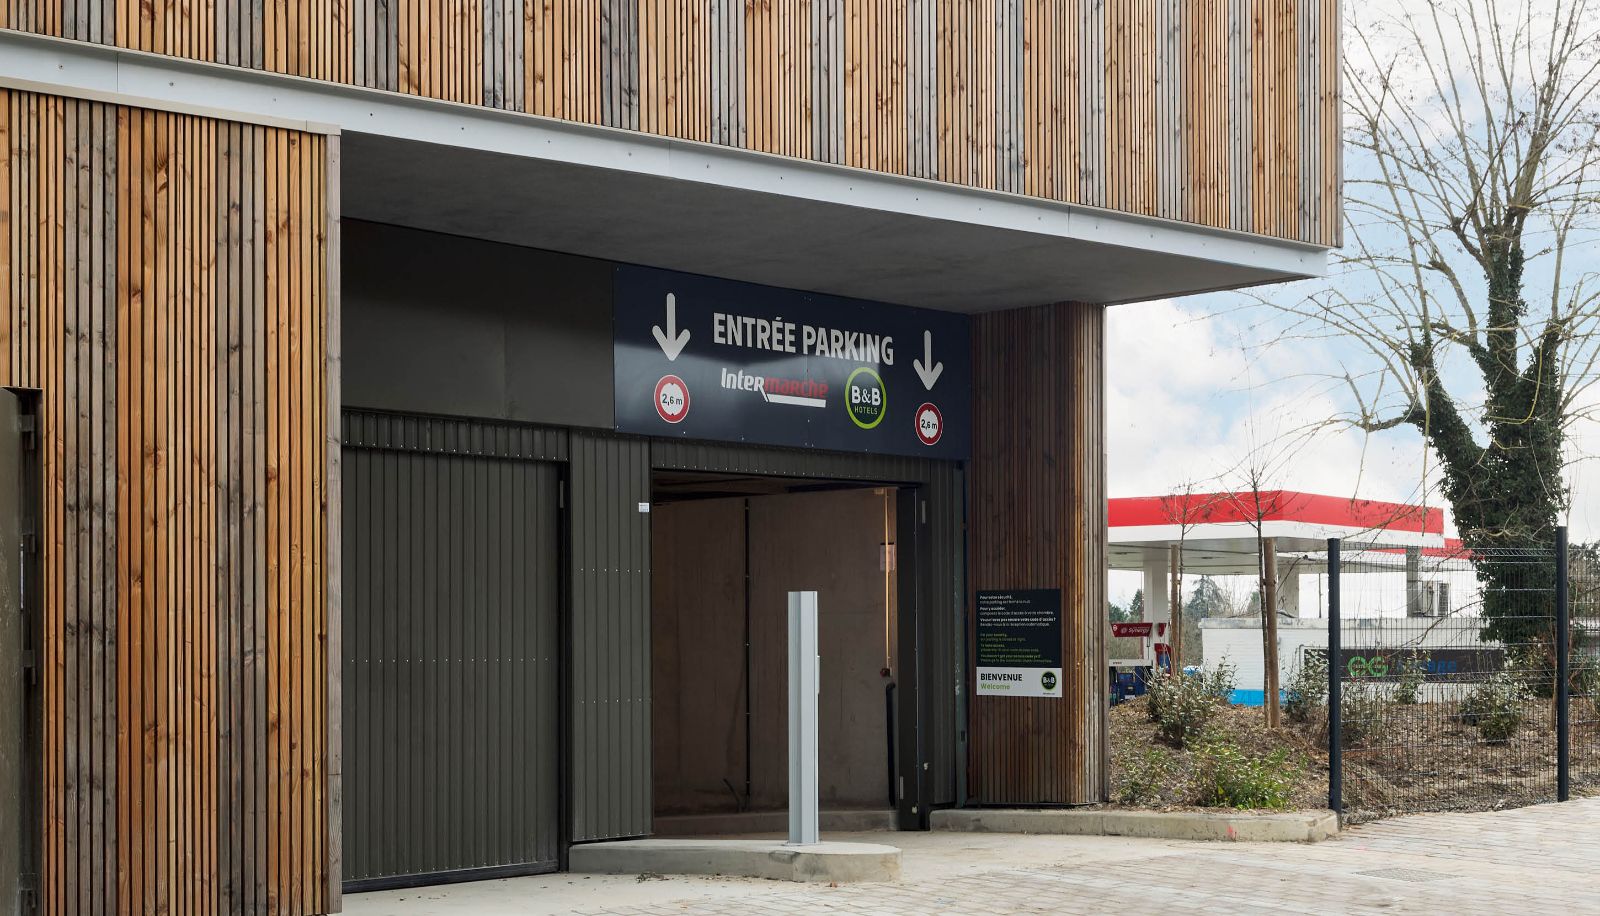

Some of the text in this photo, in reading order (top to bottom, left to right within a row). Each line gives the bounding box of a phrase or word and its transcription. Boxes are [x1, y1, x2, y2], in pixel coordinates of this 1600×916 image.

[713, 312, 894, 366] ENTRÉE PARKING
[662, 393, 675, 406] 2,6
[851, 385, 881, 406] B&B
[854, 405, 878, 415] HOTELS
[921, 419, 931, 430] 2,6
[980, 673, 1022, 681] BIENVENUE
